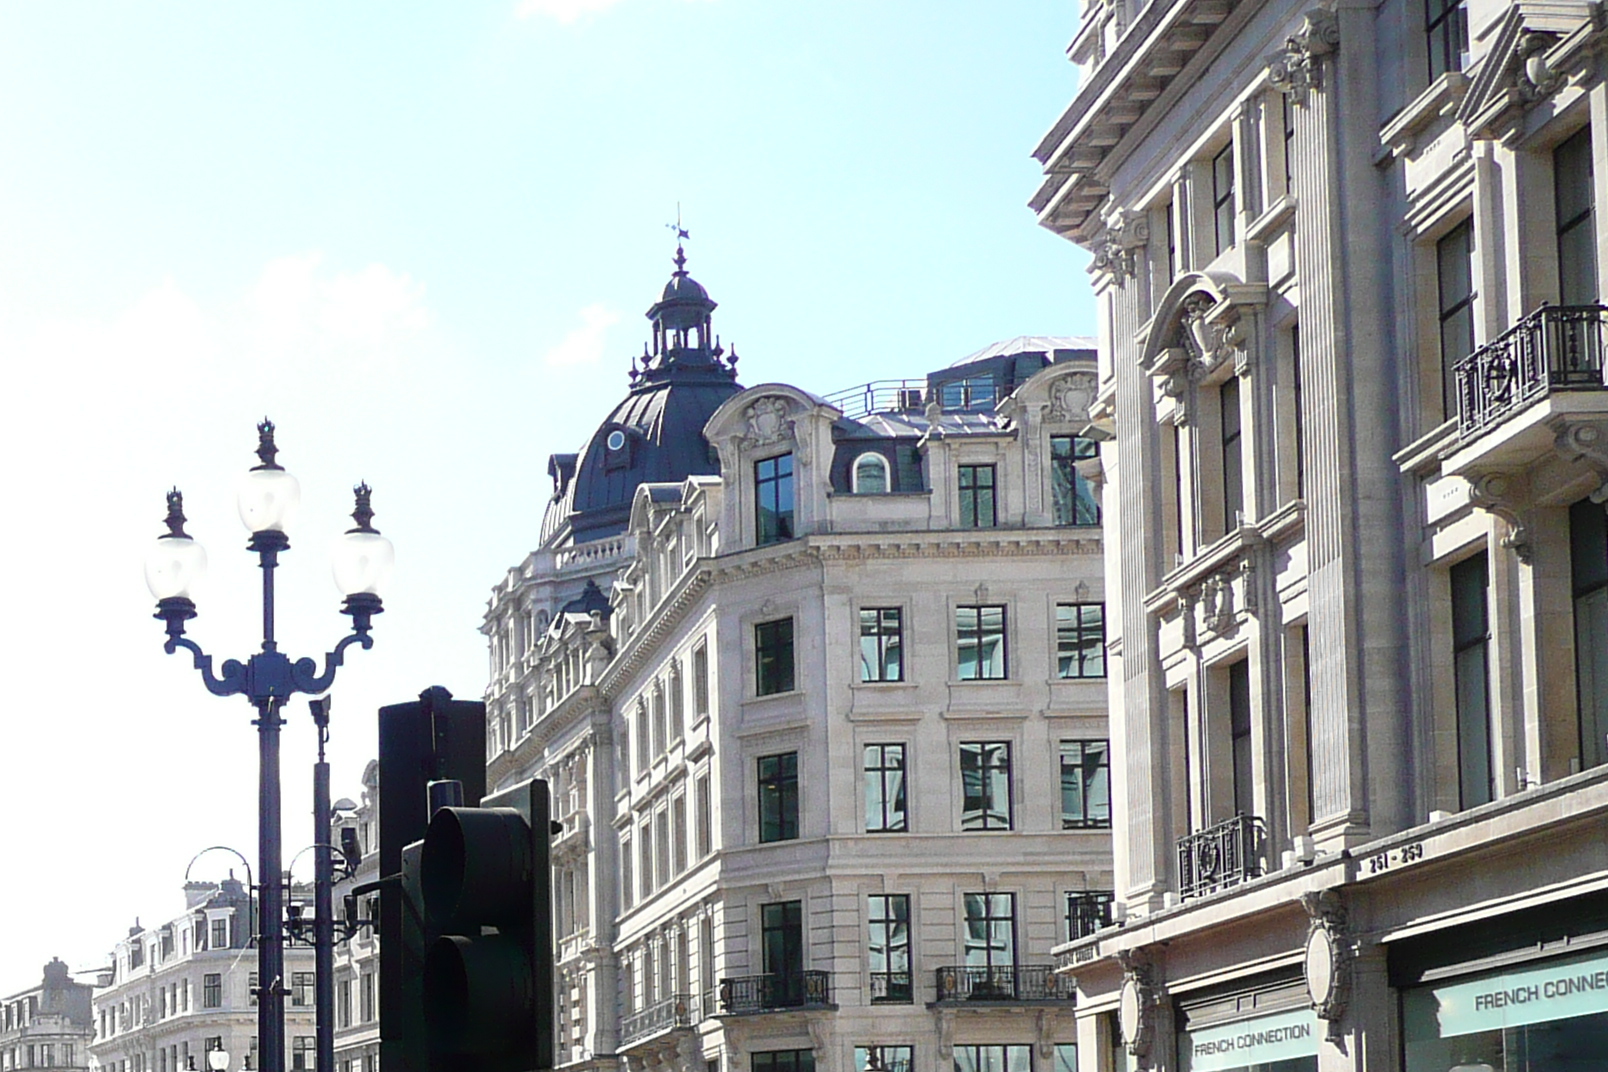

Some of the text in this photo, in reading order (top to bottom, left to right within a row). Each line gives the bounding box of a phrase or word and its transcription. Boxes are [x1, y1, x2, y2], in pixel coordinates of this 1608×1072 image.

[1369, 852, 1389, 874] 251
[1474, 970, 1608, 1011] FRENCH CONNE
[1194, 1022, 1311, 1057] FRENCH CONNECTION
